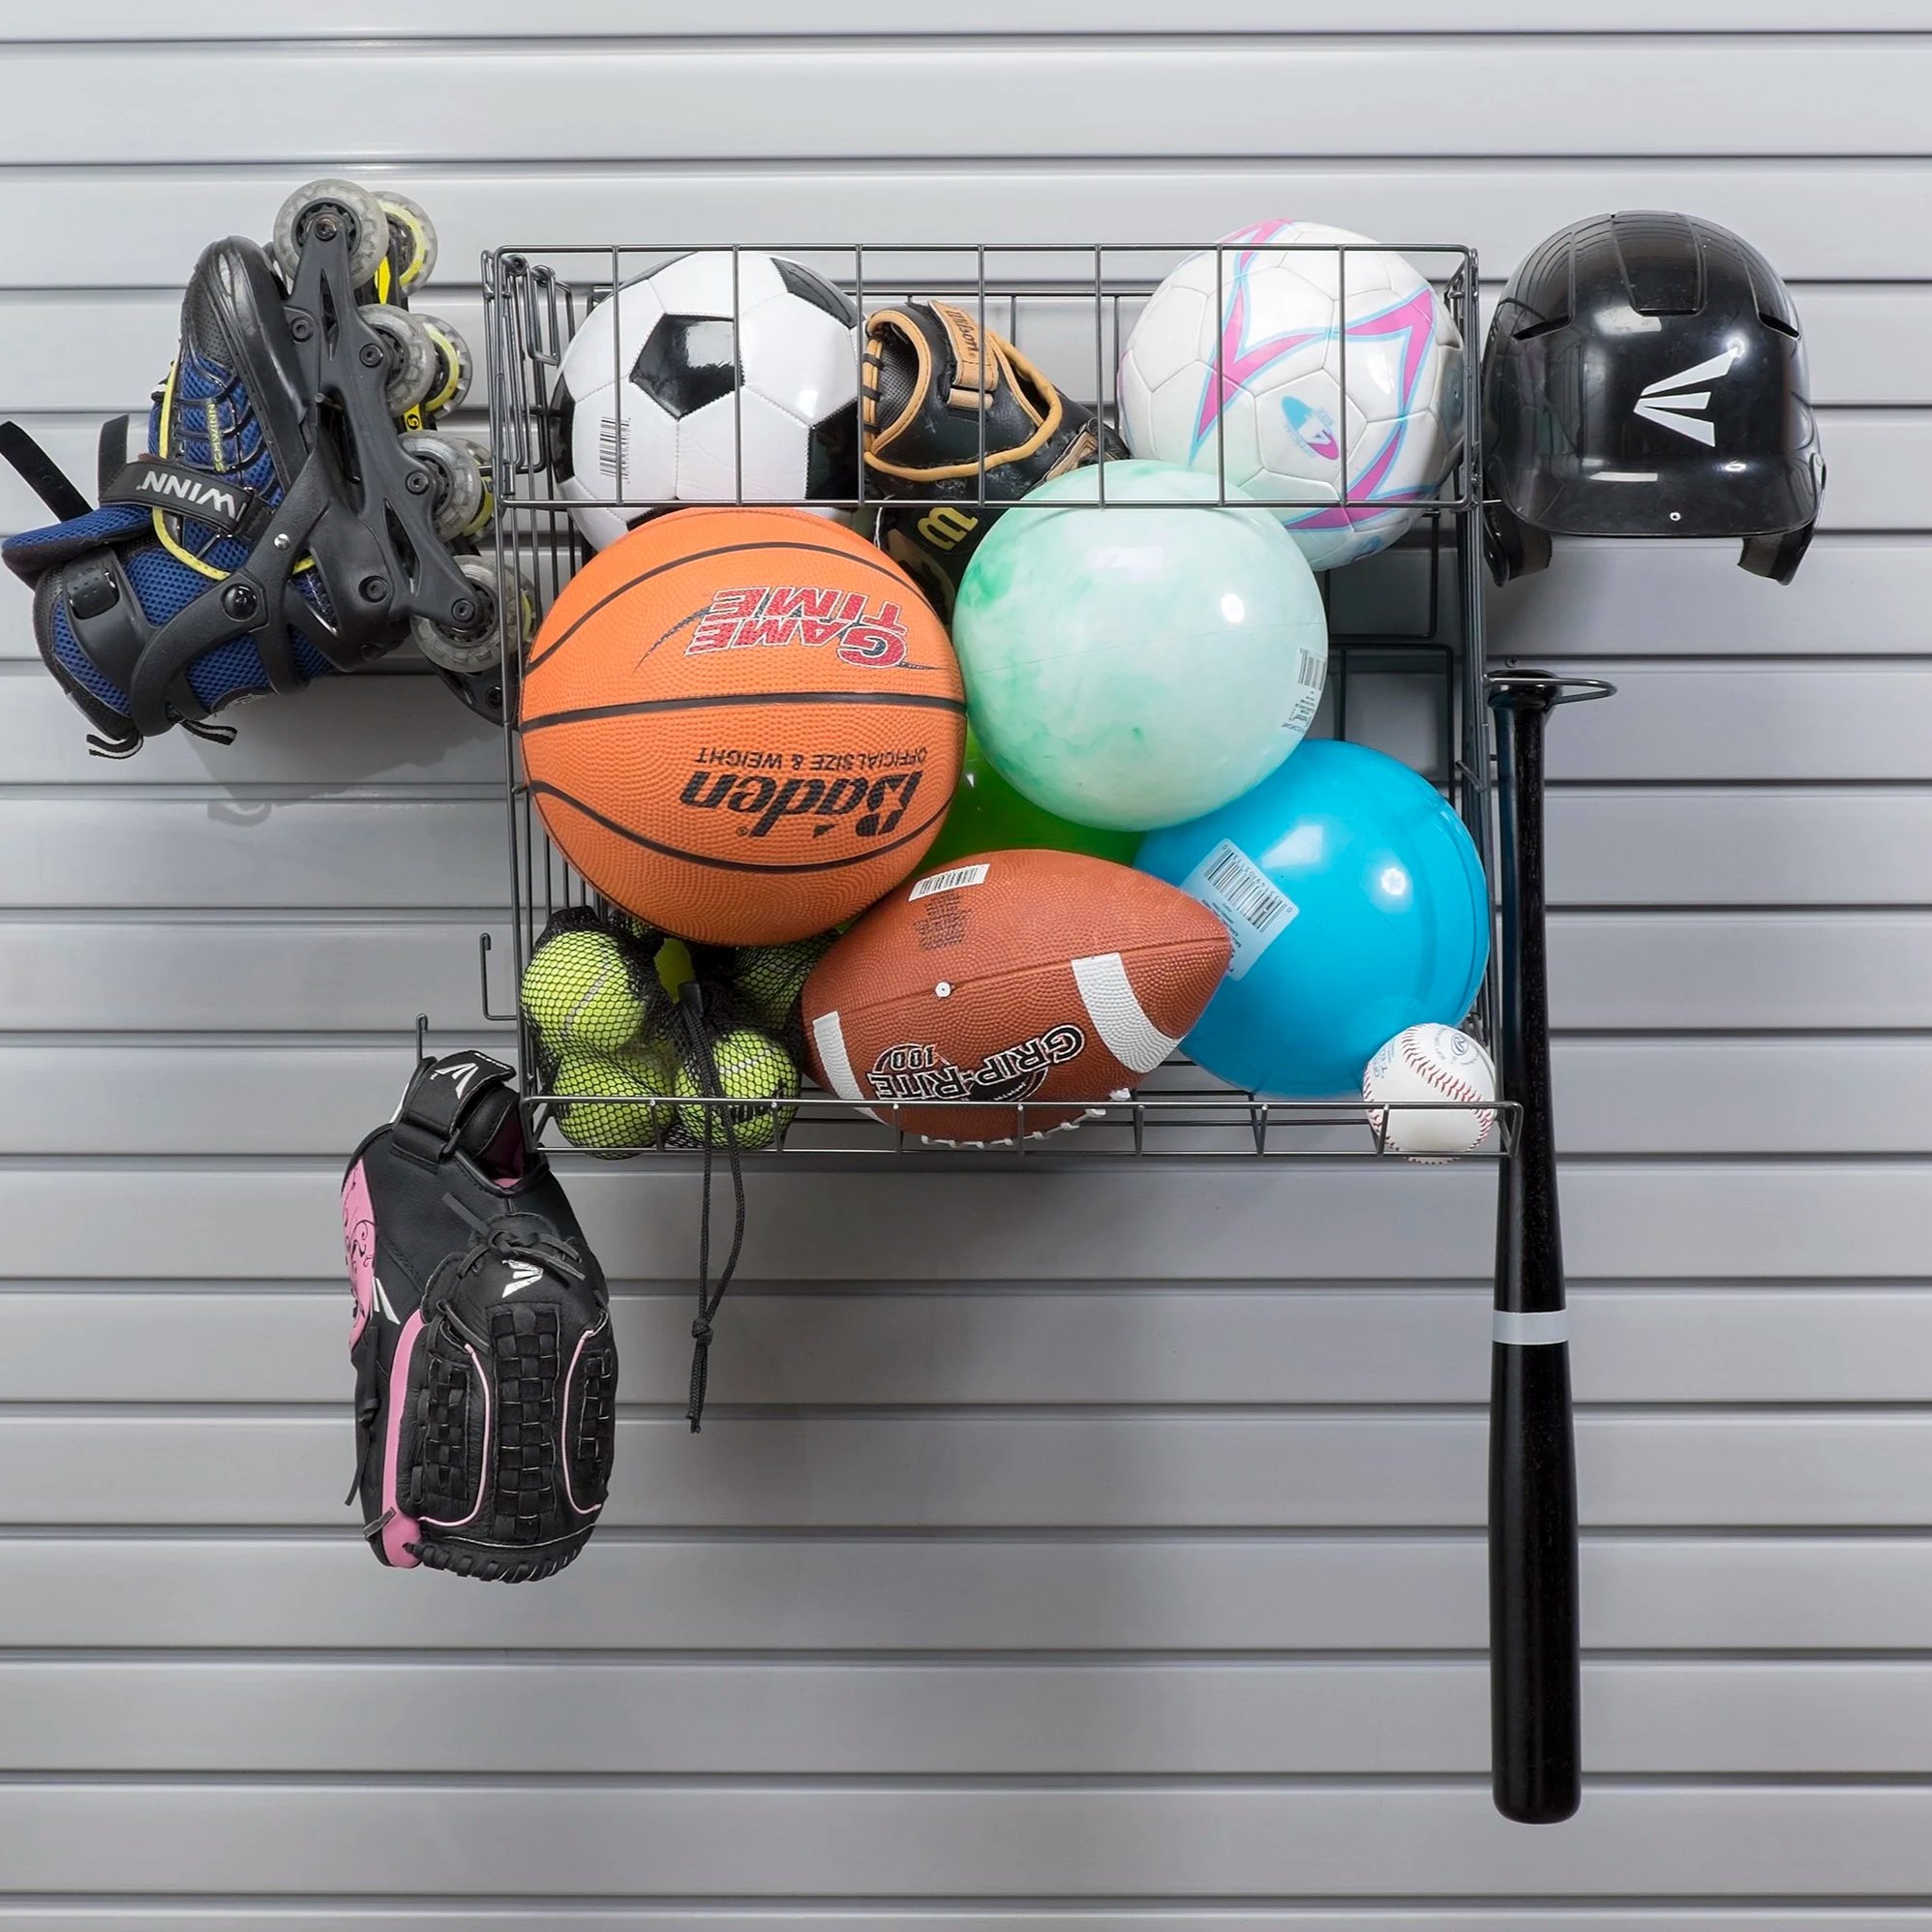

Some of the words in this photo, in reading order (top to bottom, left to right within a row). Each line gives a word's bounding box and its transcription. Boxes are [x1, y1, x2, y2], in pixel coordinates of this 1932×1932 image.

[207, 403, 224, 472] SCHWINN
[141, 470, 247, 522] WINN
[700, 586, 908, 636] TIME
[684, 618, 908, 668] GAME
[694, 746, 783, 770] WEIGHT
[792, 753, 803, 770] &
[809, 753, 855, 770] SIZE
[860, 746, 927, 770] OFFICIAL
[679, 770, 922, 838] Baden
